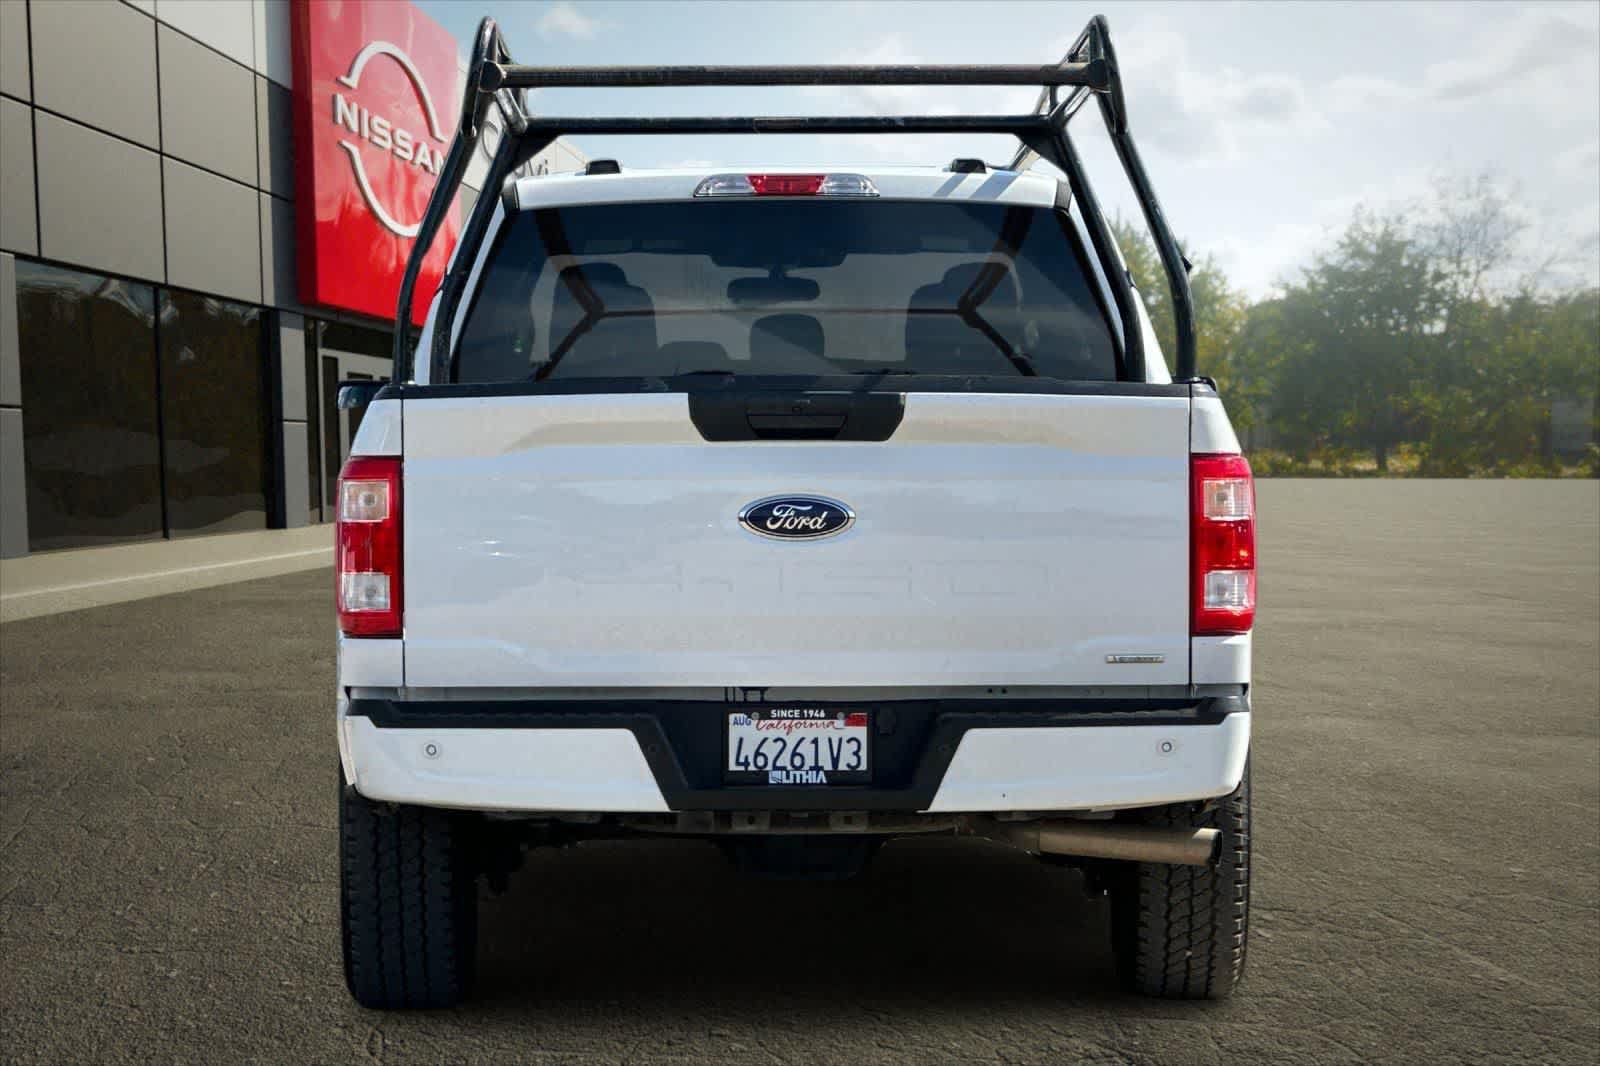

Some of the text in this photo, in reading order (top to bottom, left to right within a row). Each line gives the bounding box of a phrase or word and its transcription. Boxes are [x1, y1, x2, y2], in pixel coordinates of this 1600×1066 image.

[766, 503, 828, 530] Ford
[733, 716, 751, 726] AUG
[770, 709, 800, 718] SINCE
[755, 719, 837, 736] California
[734, 736, 862, 771] 46261V3
[783, 771, 828, 784] LITHIA
